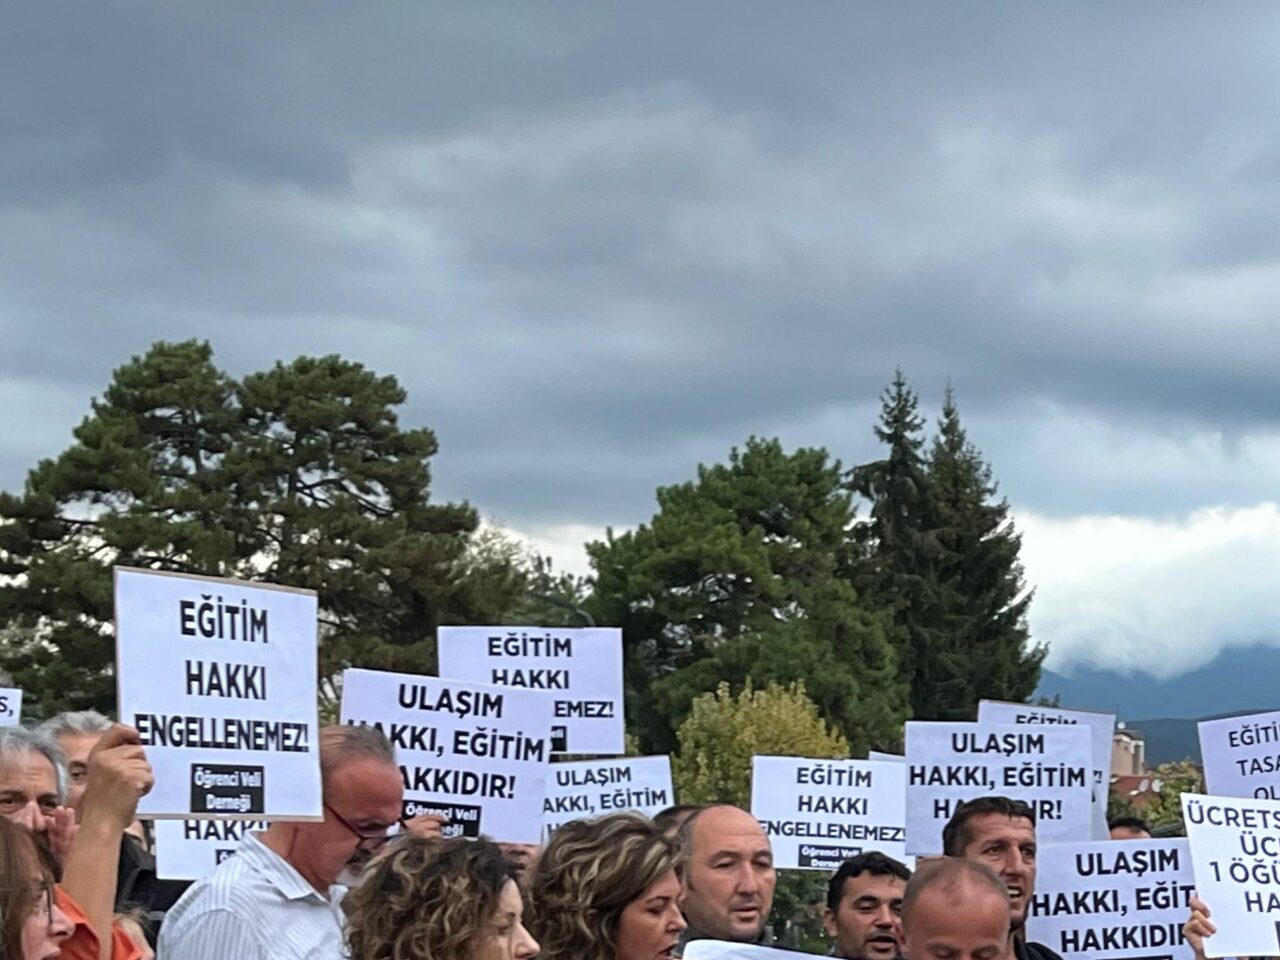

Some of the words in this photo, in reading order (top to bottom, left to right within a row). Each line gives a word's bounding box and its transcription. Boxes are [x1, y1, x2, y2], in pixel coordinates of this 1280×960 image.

[179, 594, 268, 643] EĞİTİM
[488, 632, 573, 657] EĞİTİM
[185, 659, 267, 700] HAKKI
[492, 669, 570, 689] HAKKI
[399, 683, 504, 719] ULAŞIM
[134, 713, 310, 752] ENGELLENEMEZ!
[453, 727, 545, 762] EĞİTİM
[952, 733, 1045, 757] ULAŞIM
[194, 767, 239, 787] Öğrenci
[241, 771, 262, 787] Veli
[556, 766, 632, 787] ULAŞIM
[796, 764, 872, 788] EĞİTİM
[910, 765, 996, 791] HAKKI,
[1003, 762, 1086, 788] EĞİTİM
[206, 794, 251, 812] Derneği
[543, 795, 596, 814] AKKI,
[600, 787, 667, 810] EĞİTİM
[798, 795, 868, 816] HAKKI
[455, 808, 478, 820] Veli
[1076, 849, 1180, 878] ULAŞIM
[1209, 861, 1221, 882] 1
[1033, 889, 1128, 917] HAKKI,
[1136, 881, 1196, 911] EĞİT
